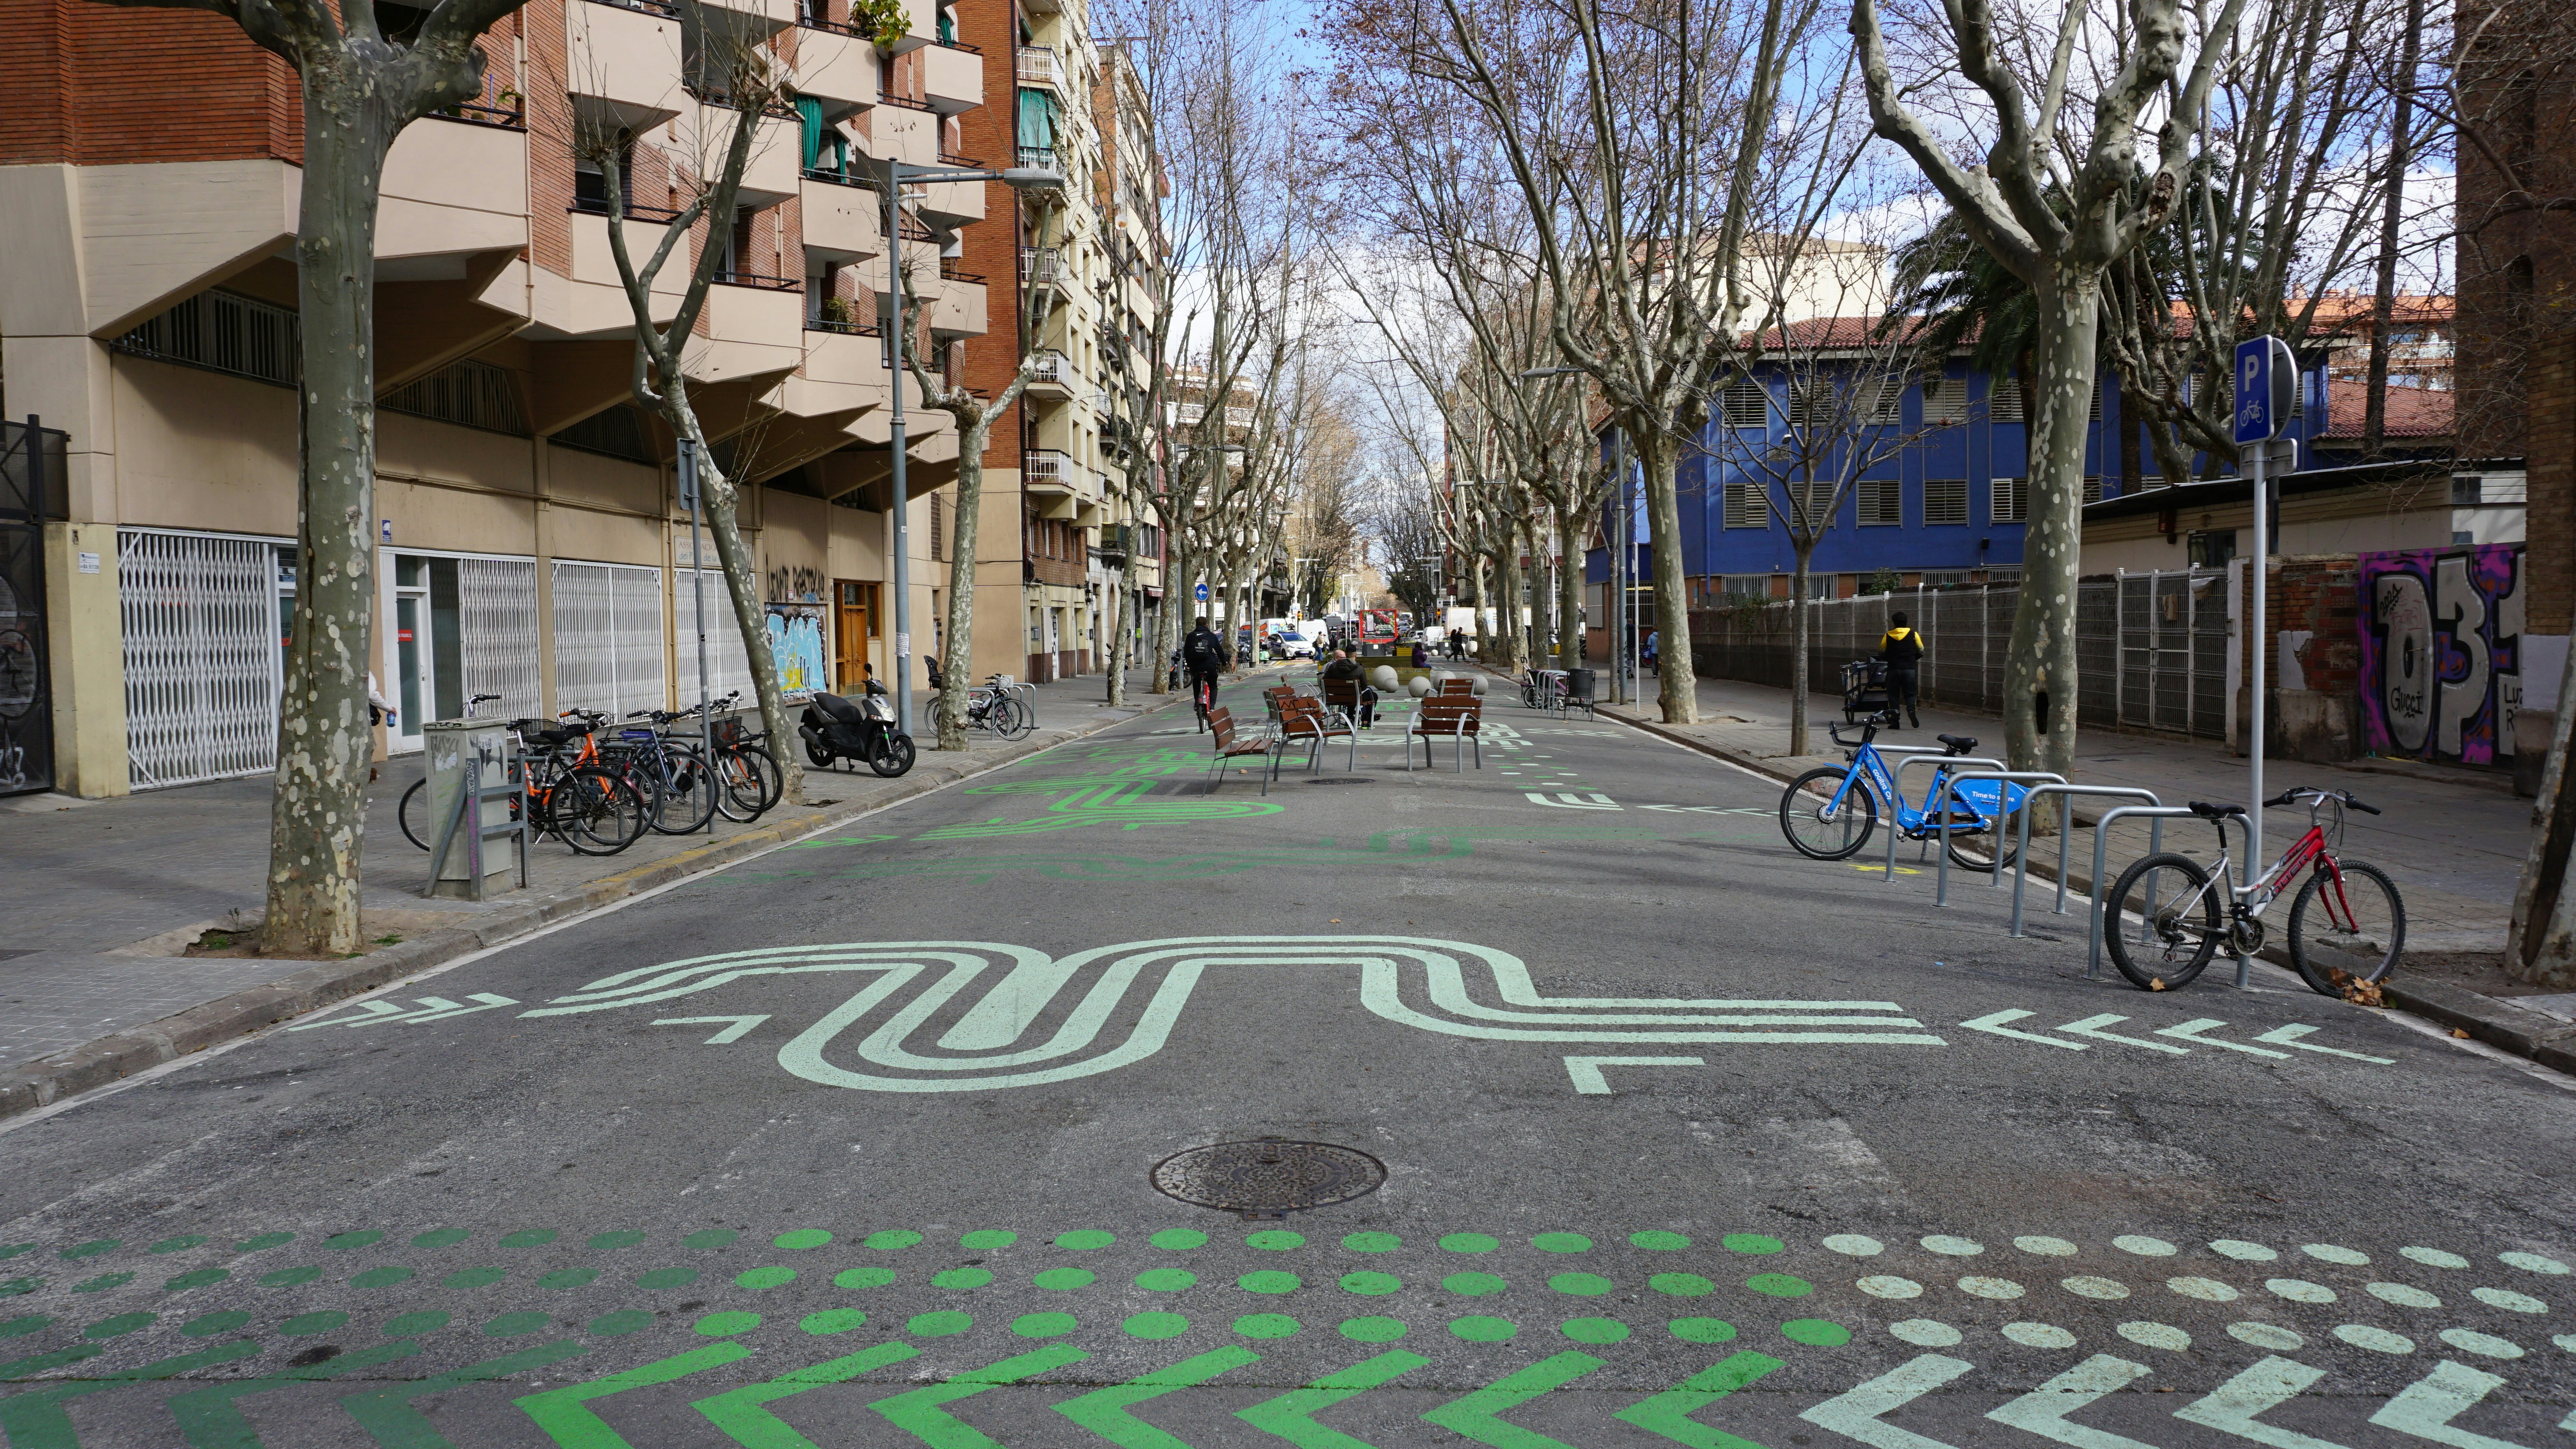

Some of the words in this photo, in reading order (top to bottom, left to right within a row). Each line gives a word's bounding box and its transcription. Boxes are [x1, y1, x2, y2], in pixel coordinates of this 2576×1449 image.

[2245, 355, 2259, 392] P
[679, 541, 716, 551] ASSOACIÓ
[679, 552, 688, 560] del
[704, 553, 711, 561] de
[2391, 686, 2423, 714] Gucci
[1873, 769, 1887, 790] cooltra
